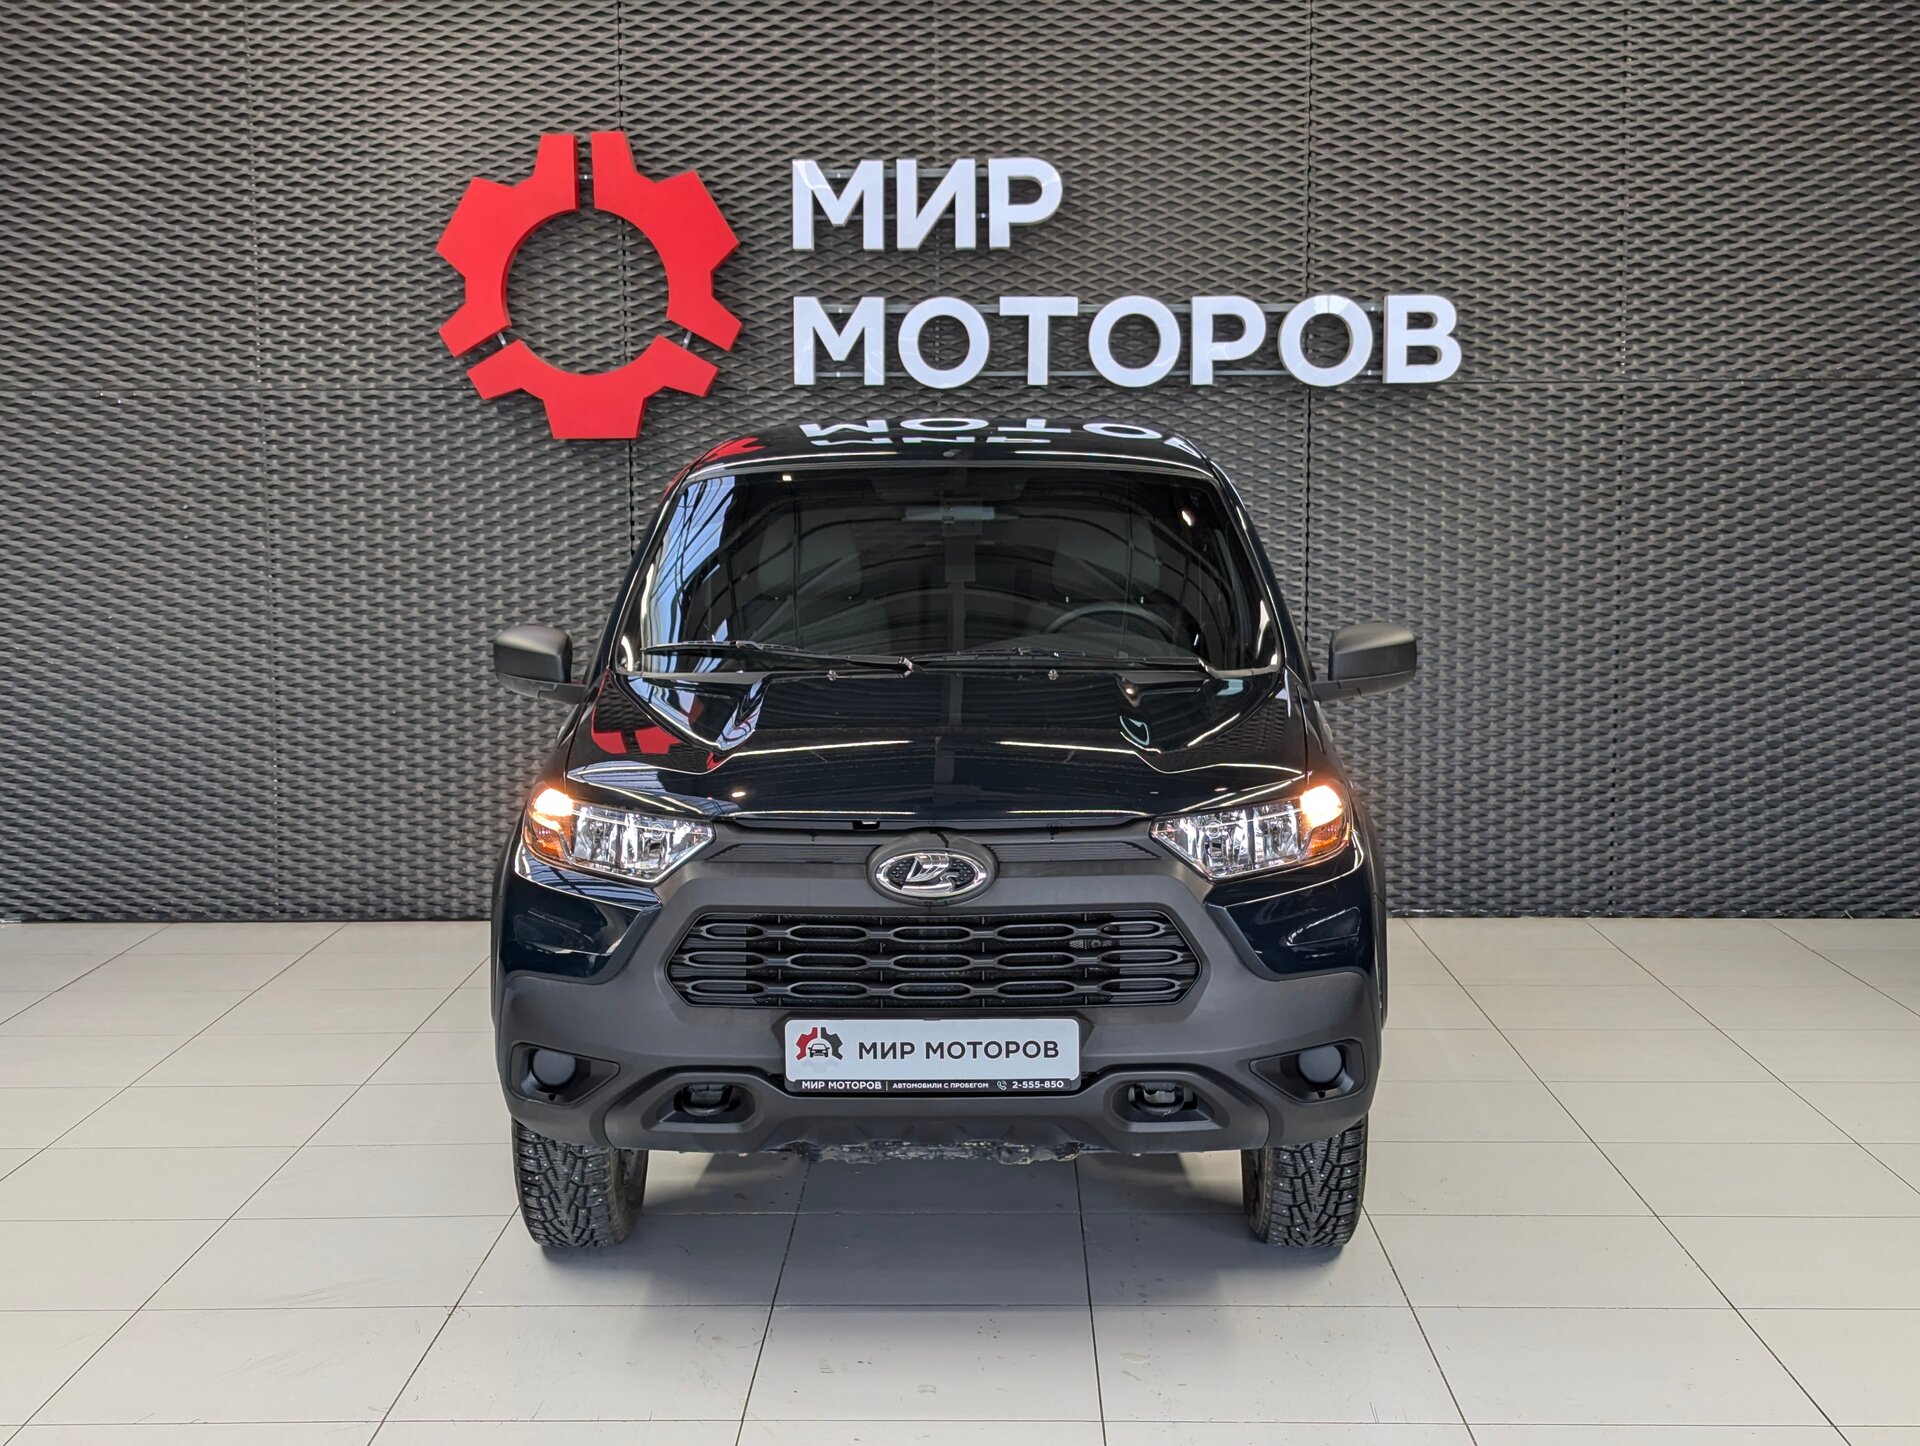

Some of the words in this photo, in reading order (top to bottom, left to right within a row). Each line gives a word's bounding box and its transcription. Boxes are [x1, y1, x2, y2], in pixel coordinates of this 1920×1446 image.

[791, 157, 1064, 250] МИР
[791, 294, 1463, 388] МОТОРОВ
[858, 1042, 915, 1060] МИР
[925, 1041, 1060, 1059] МОТОРОВ
[801, 1081, 825, 1090] МИР
[828, 1081, 882, 1090] МОТОРОВ
[1012, 1080, 1065, 1089] 2-555-850
